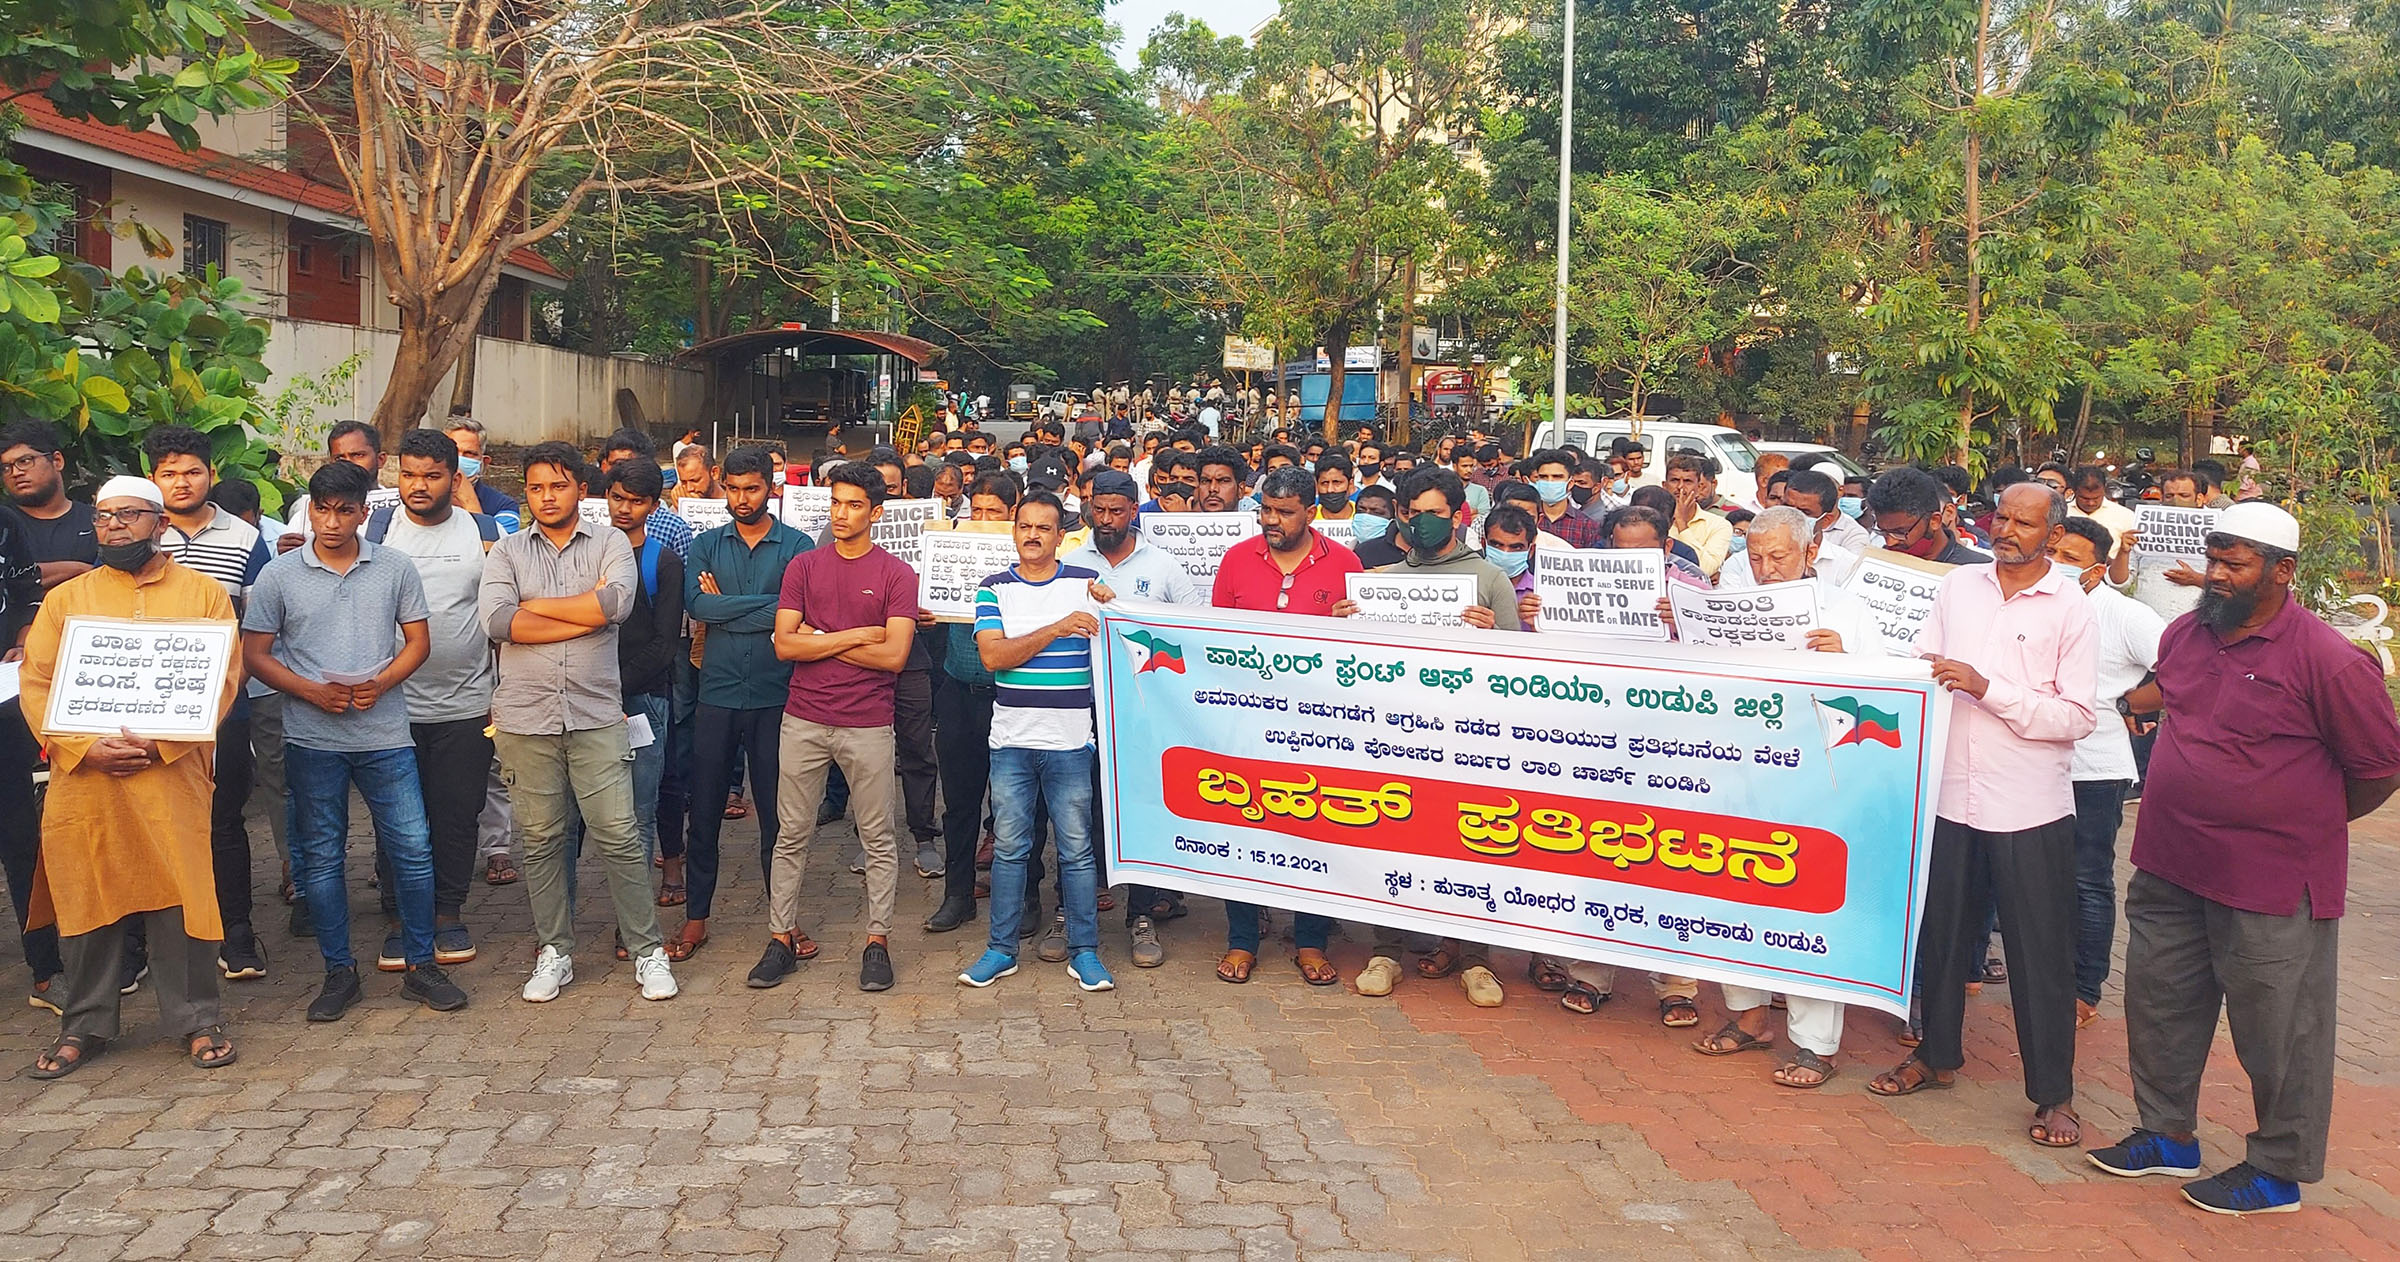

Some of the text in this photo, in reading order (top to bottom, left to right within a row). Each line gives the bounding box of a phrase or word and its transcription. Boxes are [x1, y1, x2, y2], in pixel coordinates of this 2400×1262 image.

[874, 506, 934, 523] ENCE
[2140, 510, 2215, 526] SILENCE
[1152, 521, 1242, 545] ಅನ್ಯಾಯದ
[1328, 527, 1356, 537] KHA
[977, 541, 1018, 555] ನ್ಯಾಯ
[2137, 543, 2207, 555] VIOLENC
[984, 555, 1020, 567] ಮರೆ
[1540, 554, 1585, 573] WEAR
[1589, 558, 1643, 574] KHAKI
[1540, 574, 1656, 591] PROTECT AND SERVE
[1863, 571, 1940, 602] ಅನ್ಯಾಯ
[1359, 585, 1459, 610] ಅನ್ಯಾಯದ
[1567, 591, 1629, 609] NOT TO
[1704, 596, 1775, 613] ಶಾಂತಿ
[1542, 606, 1660, 628] VIOLATE OR HATE
[1680, 607, 1811, 627] ಕಾಪಾಡಬೇಕಾದ
[153, 633, 206, 655] ಧರಿಸಿ
[1706, 626, 1786, 647] ರಕ್ಷಕರೇ
[79, 653, 211, 675] ನಾಗರಿಕರ ರಕ್ಷಣೆಗೆ
[154, 672, 208, 699] ದ್ವೇಷ
[1205, 644, 1784, 730] ಪಾಪ್ಯುಲರ್ ಫ್ರಂಟ್ ಆಫ್ ಇಂಡಿಯಾ, ಉಡುಪಿ ಜಿಲ್ಲೆ
[174, 702, 203, 720] ಅಲ್ಲ
[1194, 689, 1801, 768] ಅಮಾಯಕರ ಬಿಡುಗಡೆಗೆ ಆಗ್ರಹಿಸಿ ನಡೆದ ಶಾಂತಿಯುತ ಪ್ರತಿಭಟನೆಯ ವೇಳೆ
[1265, 729, 1711, 794] ಉಪ್ಪಿನಂಗಡಿ ಪೊಲೀಸರ ಬರ್ಬರ ಲಾಠಿ ಚಾರ್ಜ್ ಖಂಡಿಸಿ
[1197, 768, 1799, 886] ಬೃಹತ್ ಪ್ರತಿಭಟನೆ
[1174, 835, 1230, 860] ದಿನಾಂಕ
[1249, 850, 1328, 874] 15.12.2021
[1384, 870, 1412, 898] ಸ್ಥಳ
[1433, 877, 1497, 914] ಹುತಾತ್ಮ
[1503, 886, 1576, 914] ಯೋಧರ
[1584, 900, 1649, 932] ಸ್ಮಾರಕ,
[1658, 913, 1754, 943] ಅಜ್ಜರಕಾಡು
[1763, 931, 1827, 954] ಉಡುಪಿ
